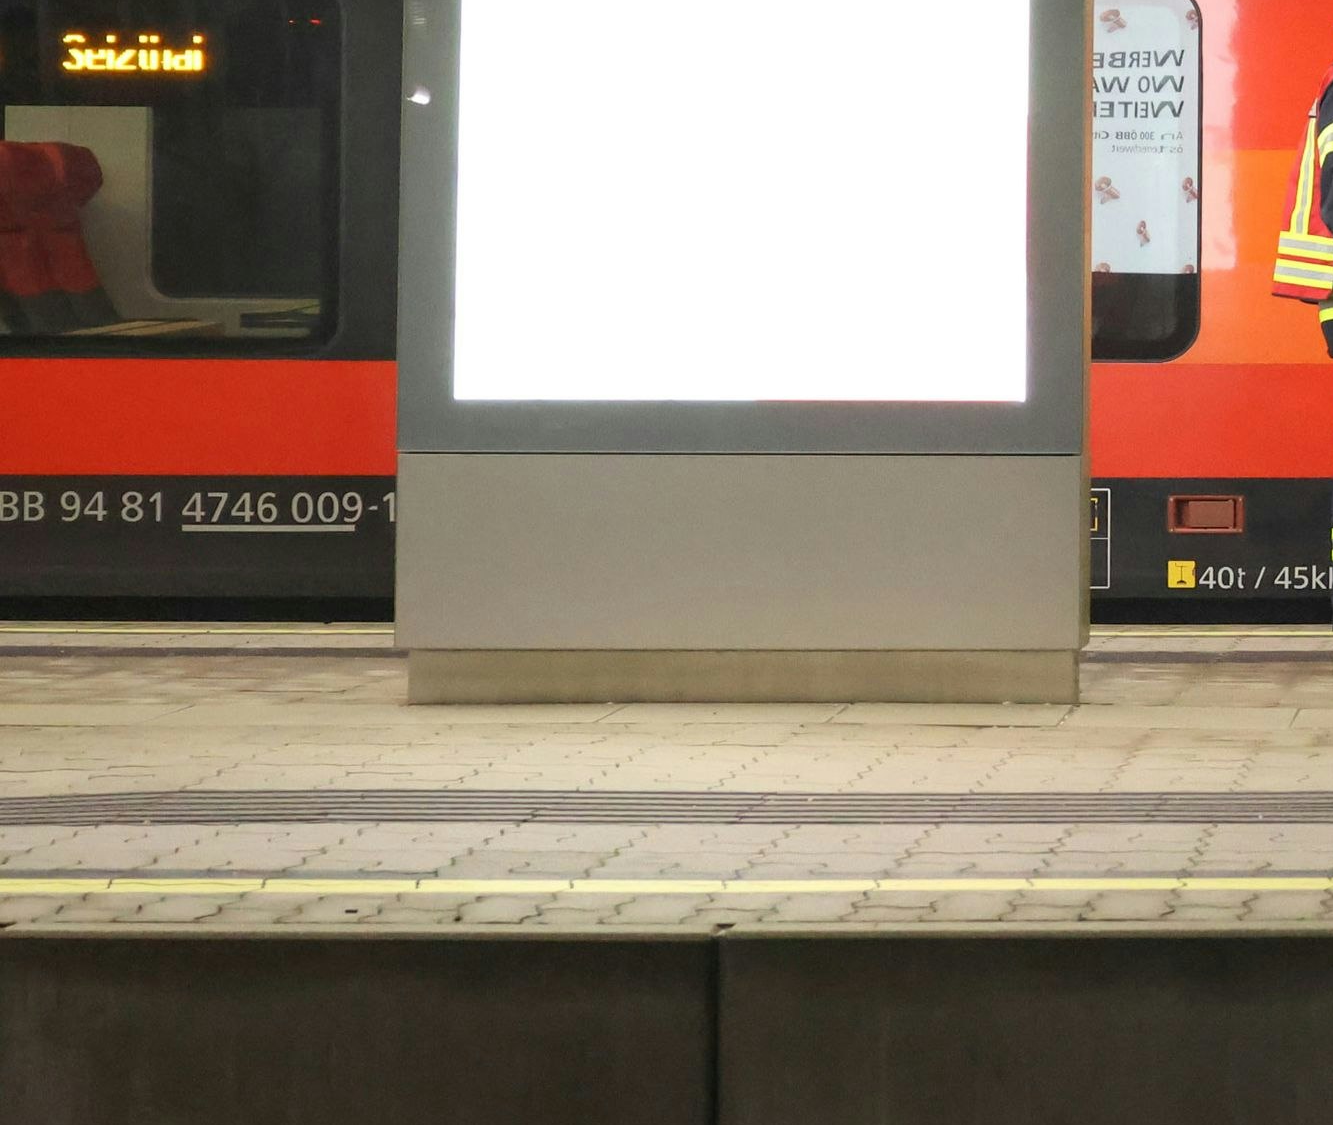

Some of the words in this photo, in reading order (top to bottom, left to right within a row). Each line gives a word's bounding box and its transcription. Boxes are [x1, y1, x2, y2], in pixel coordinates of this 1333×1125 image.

[60, 491, 107, 522] 94
[121, 491, 163, 522] 81
[182, 492, 278, 523] 4746
[1199, 565, 1246, 589] 40t
[1254, 566, 1266, 589] /
